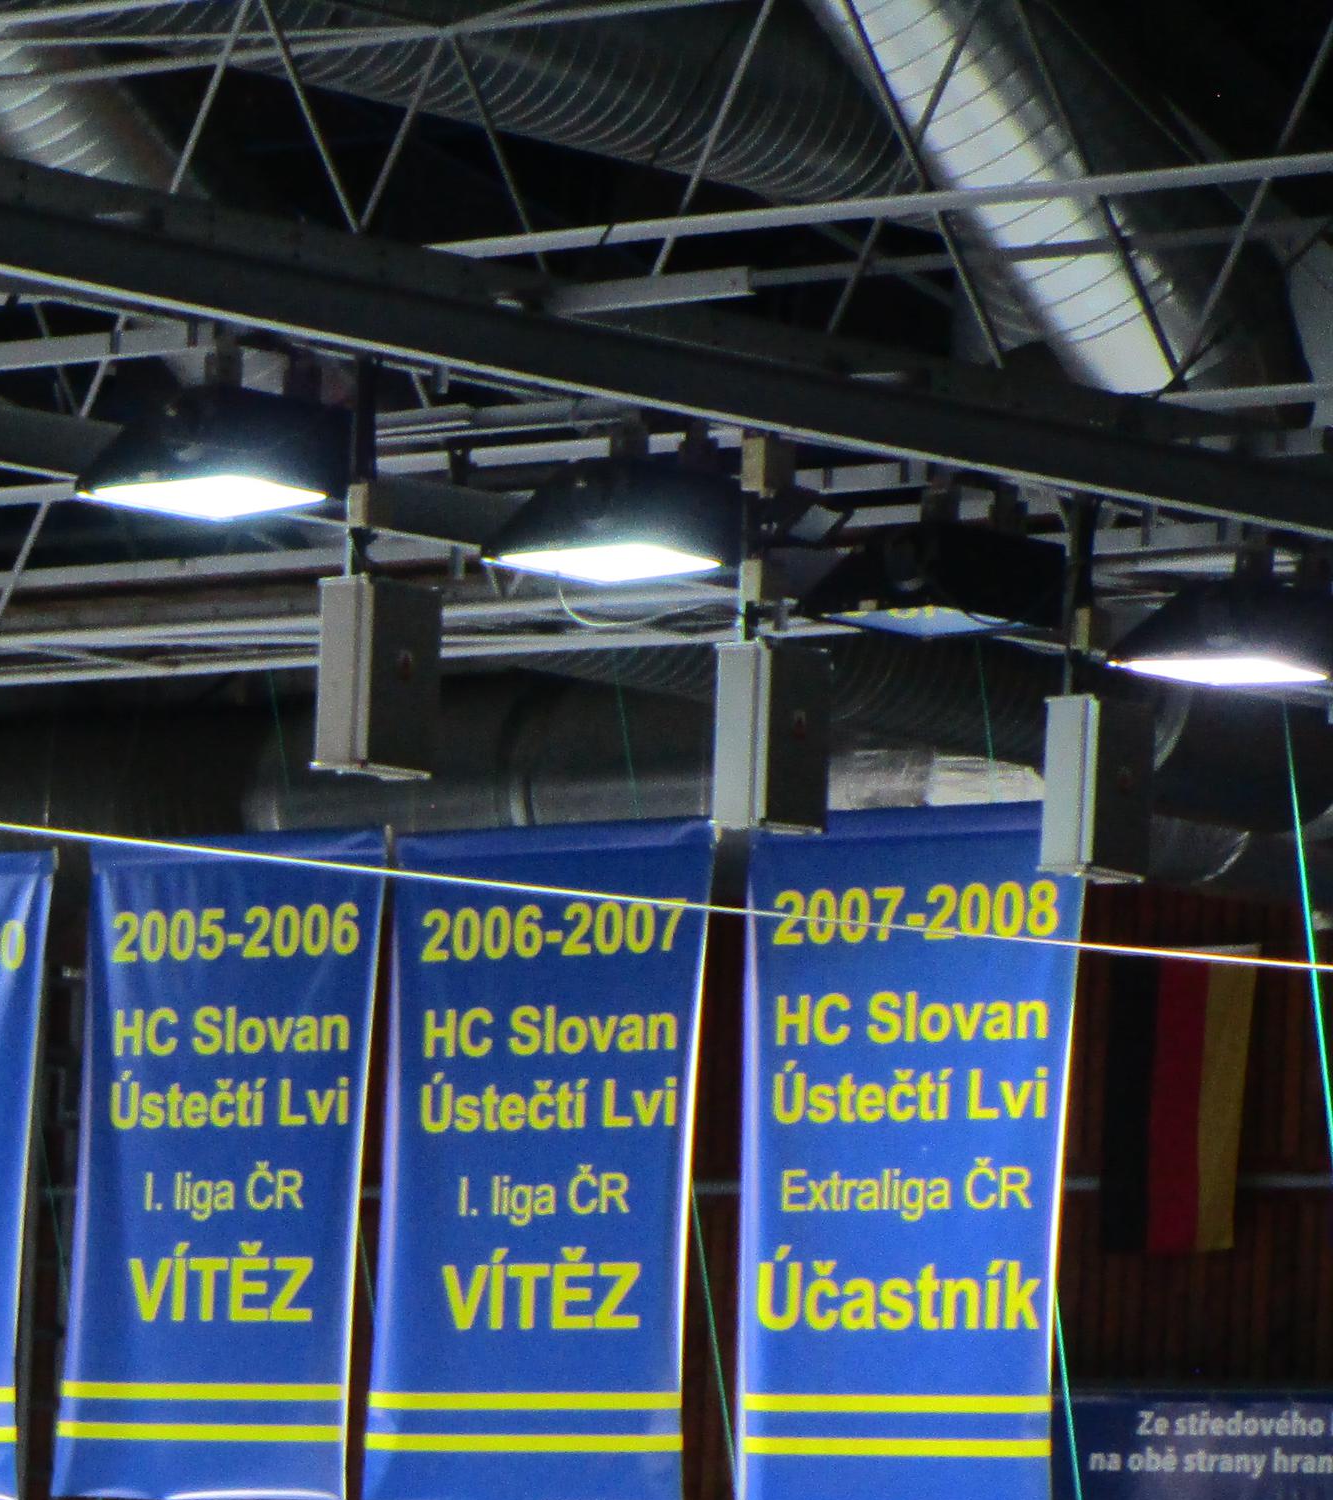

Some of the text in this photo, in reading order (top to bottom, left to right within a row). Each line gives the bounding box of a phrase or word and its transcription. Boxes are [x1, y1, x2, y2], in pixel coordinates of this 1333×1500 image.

[113, 902, 360, 962] 2005-2006
[422, 899, 688, 962] 2006-2007
[773, 880, 1058, 945] 2007-2008
[115, 1006, 350, 1056] HC Slovan
[424, 1005, 676, 1057] HC Slovan
[776, 992, 1048, 1045] HC Slovan
[110, 1072, 349, 1129] Ústečtí Lvi
[421, 1073, 677, 1133] Ústečtí Lvi
[773, 1060, 1048, 1124] Ústečtí Lvi
[174, 1172, 235, 1221] liga
[246, 1161, 303, 1211] ČR
[492, 1176, 557, 1226] liga
[568, 1164, 629, 1215] ČR
[781, 1157, 1032, 1221] Extraliga ČR
[130, 1242, 313, 1321] VÍTĚZ
[443, 1248, 640, 1329] VÍTĚZ
[756, 1245, 1040, 1330] Účastník
[1136, 1411, 1169, 1436] Ze
[1174, 1411, 1325, 1438] středového
[1089, 1451, 1122, 1472] na
[1127, 1446, 1177, 1473] obě
[1182, 1448, 1267, 1479] strany
